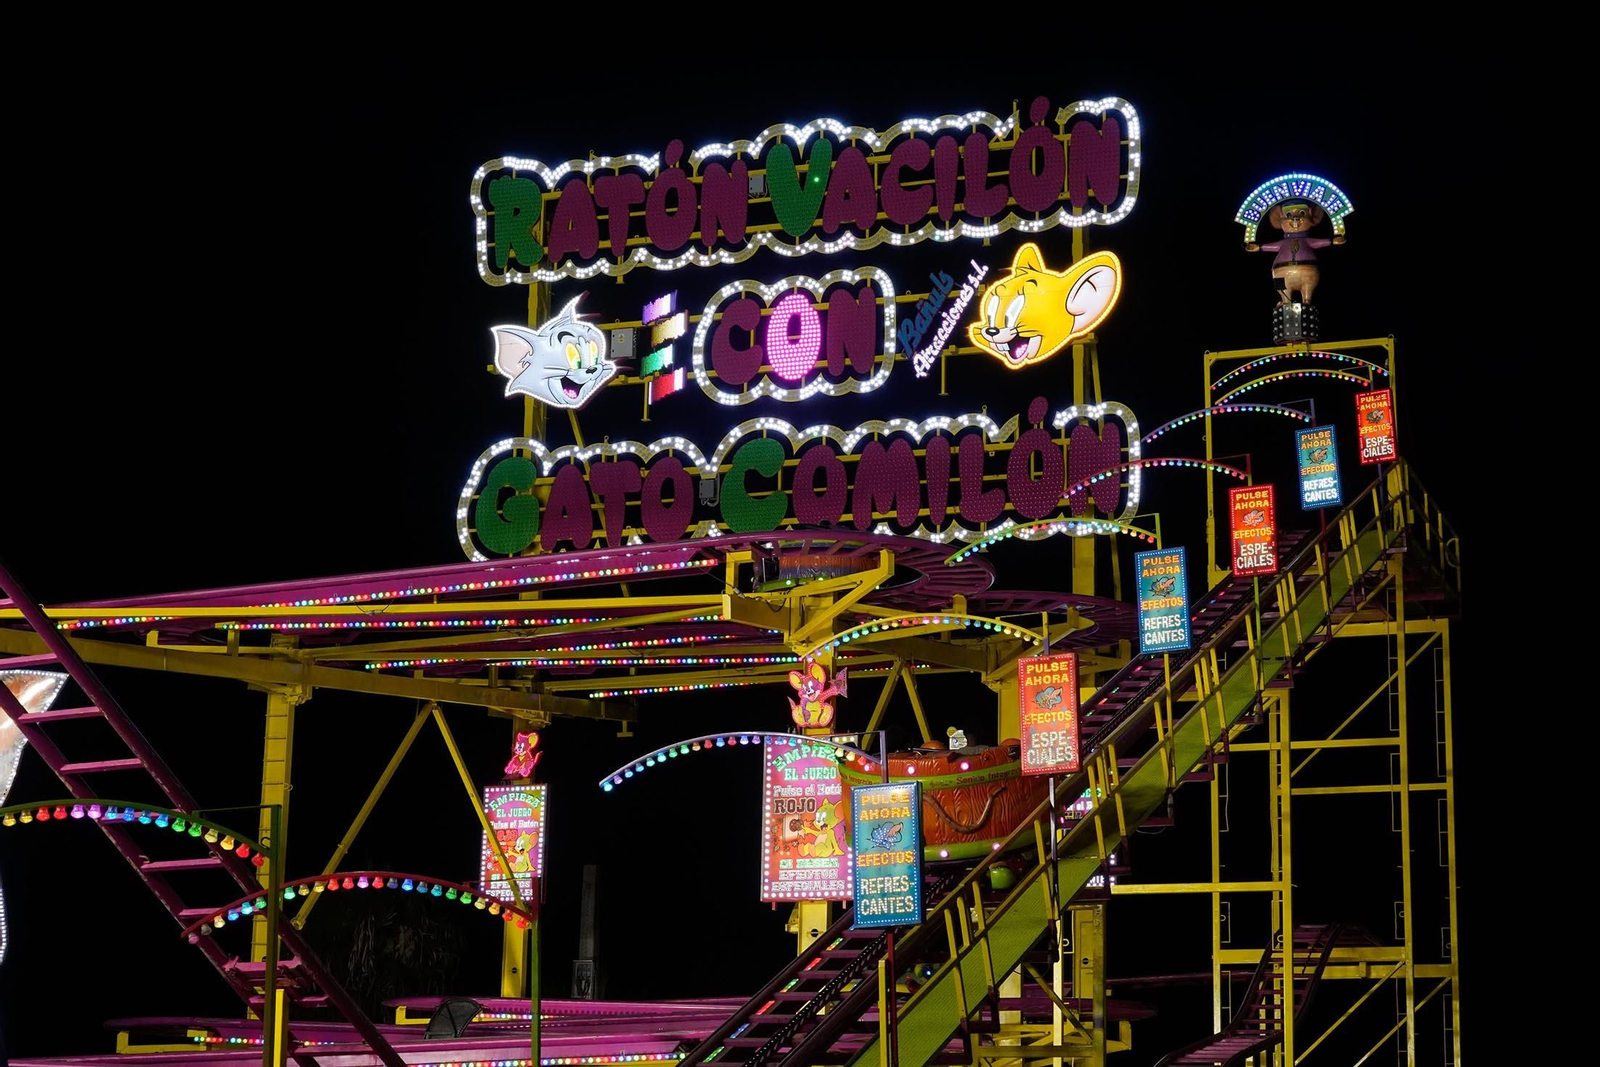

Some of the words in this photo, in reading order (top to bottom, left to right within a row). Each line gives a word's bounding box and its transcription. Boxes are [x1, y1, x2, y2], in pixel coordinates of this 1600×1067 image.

[489, 139, 748, 268] RATÓN
[766, 97, 1121, 236] VACILÓN
[1243, 181, 1290, 222] BUEN
[1292, 180, 1344, 214] VIAJE
[711, 286, 876, 387] CON
[1301, 430, 1331, 441] PULSE
[1361, 423, 1391, 434] EFECTOS
[1301, 439, 1332, 450] AHORA
[1366, 436, 1392, 448] ESPE-
[1363, 444, 1393, 458] CIALES
[475, 457, 692, 554] GATO
[719, 396, 1121, 533] COMILÓN
[1301, 463, 1336, 476] EFECTOS
[1304, 476, 1338, 491] REFRES-
[1235, 491, 1269, 501] PULSE
[1304, 488, 1338, 502] CANTES
[1235, 499, 1269, 510] AHORA
[1234, 527, 1272, 539] EFECTOS
[1240, 542, 1273, 556] ESPE-
[1143, 555, 1180, 566] PULSE
[1237, 553, 1274, 569] CIALES
[1142, 565, 1181, 577] AHORA
[1141, 597, 1184, 610] EFECTOS
[1144, 614, 1185, 631] REFRES-
[1144, 628, 1185, 645] CANTES
[1026, 661, 1069, 674] PULSE
[1025, 673, 1069, 686] AHORA
[1024, 710, 1072, 725] EFECTOS
[1031, 730, 1072, 748] ESPE-
[772, 743, 839, 771] EMPIEZ
[1027, 745, 1074, 765] CIALES
[784, 768, 799, 781] EL
[801, 766, 837, 780] JUEGO
[956, 775, 985, 785] Sonido
[773, 784, 803, 797] Pulse
[805, 784, 816, 796] el
[489, 792, 541, 811] EMPIEZA
[773, 797, 817, 814] ROJO
[861, 792, 910, 806] PULSE
[496, 808, 507, 818] EL
[508, 807, 532, 817] JUEGO
[859, 806, 911, 820] AHORA
[858, 851, 914, 867] EFECTOS
[860, 875, 915, 895] REFRES-
[861, 895, 914, 916] CANTES
